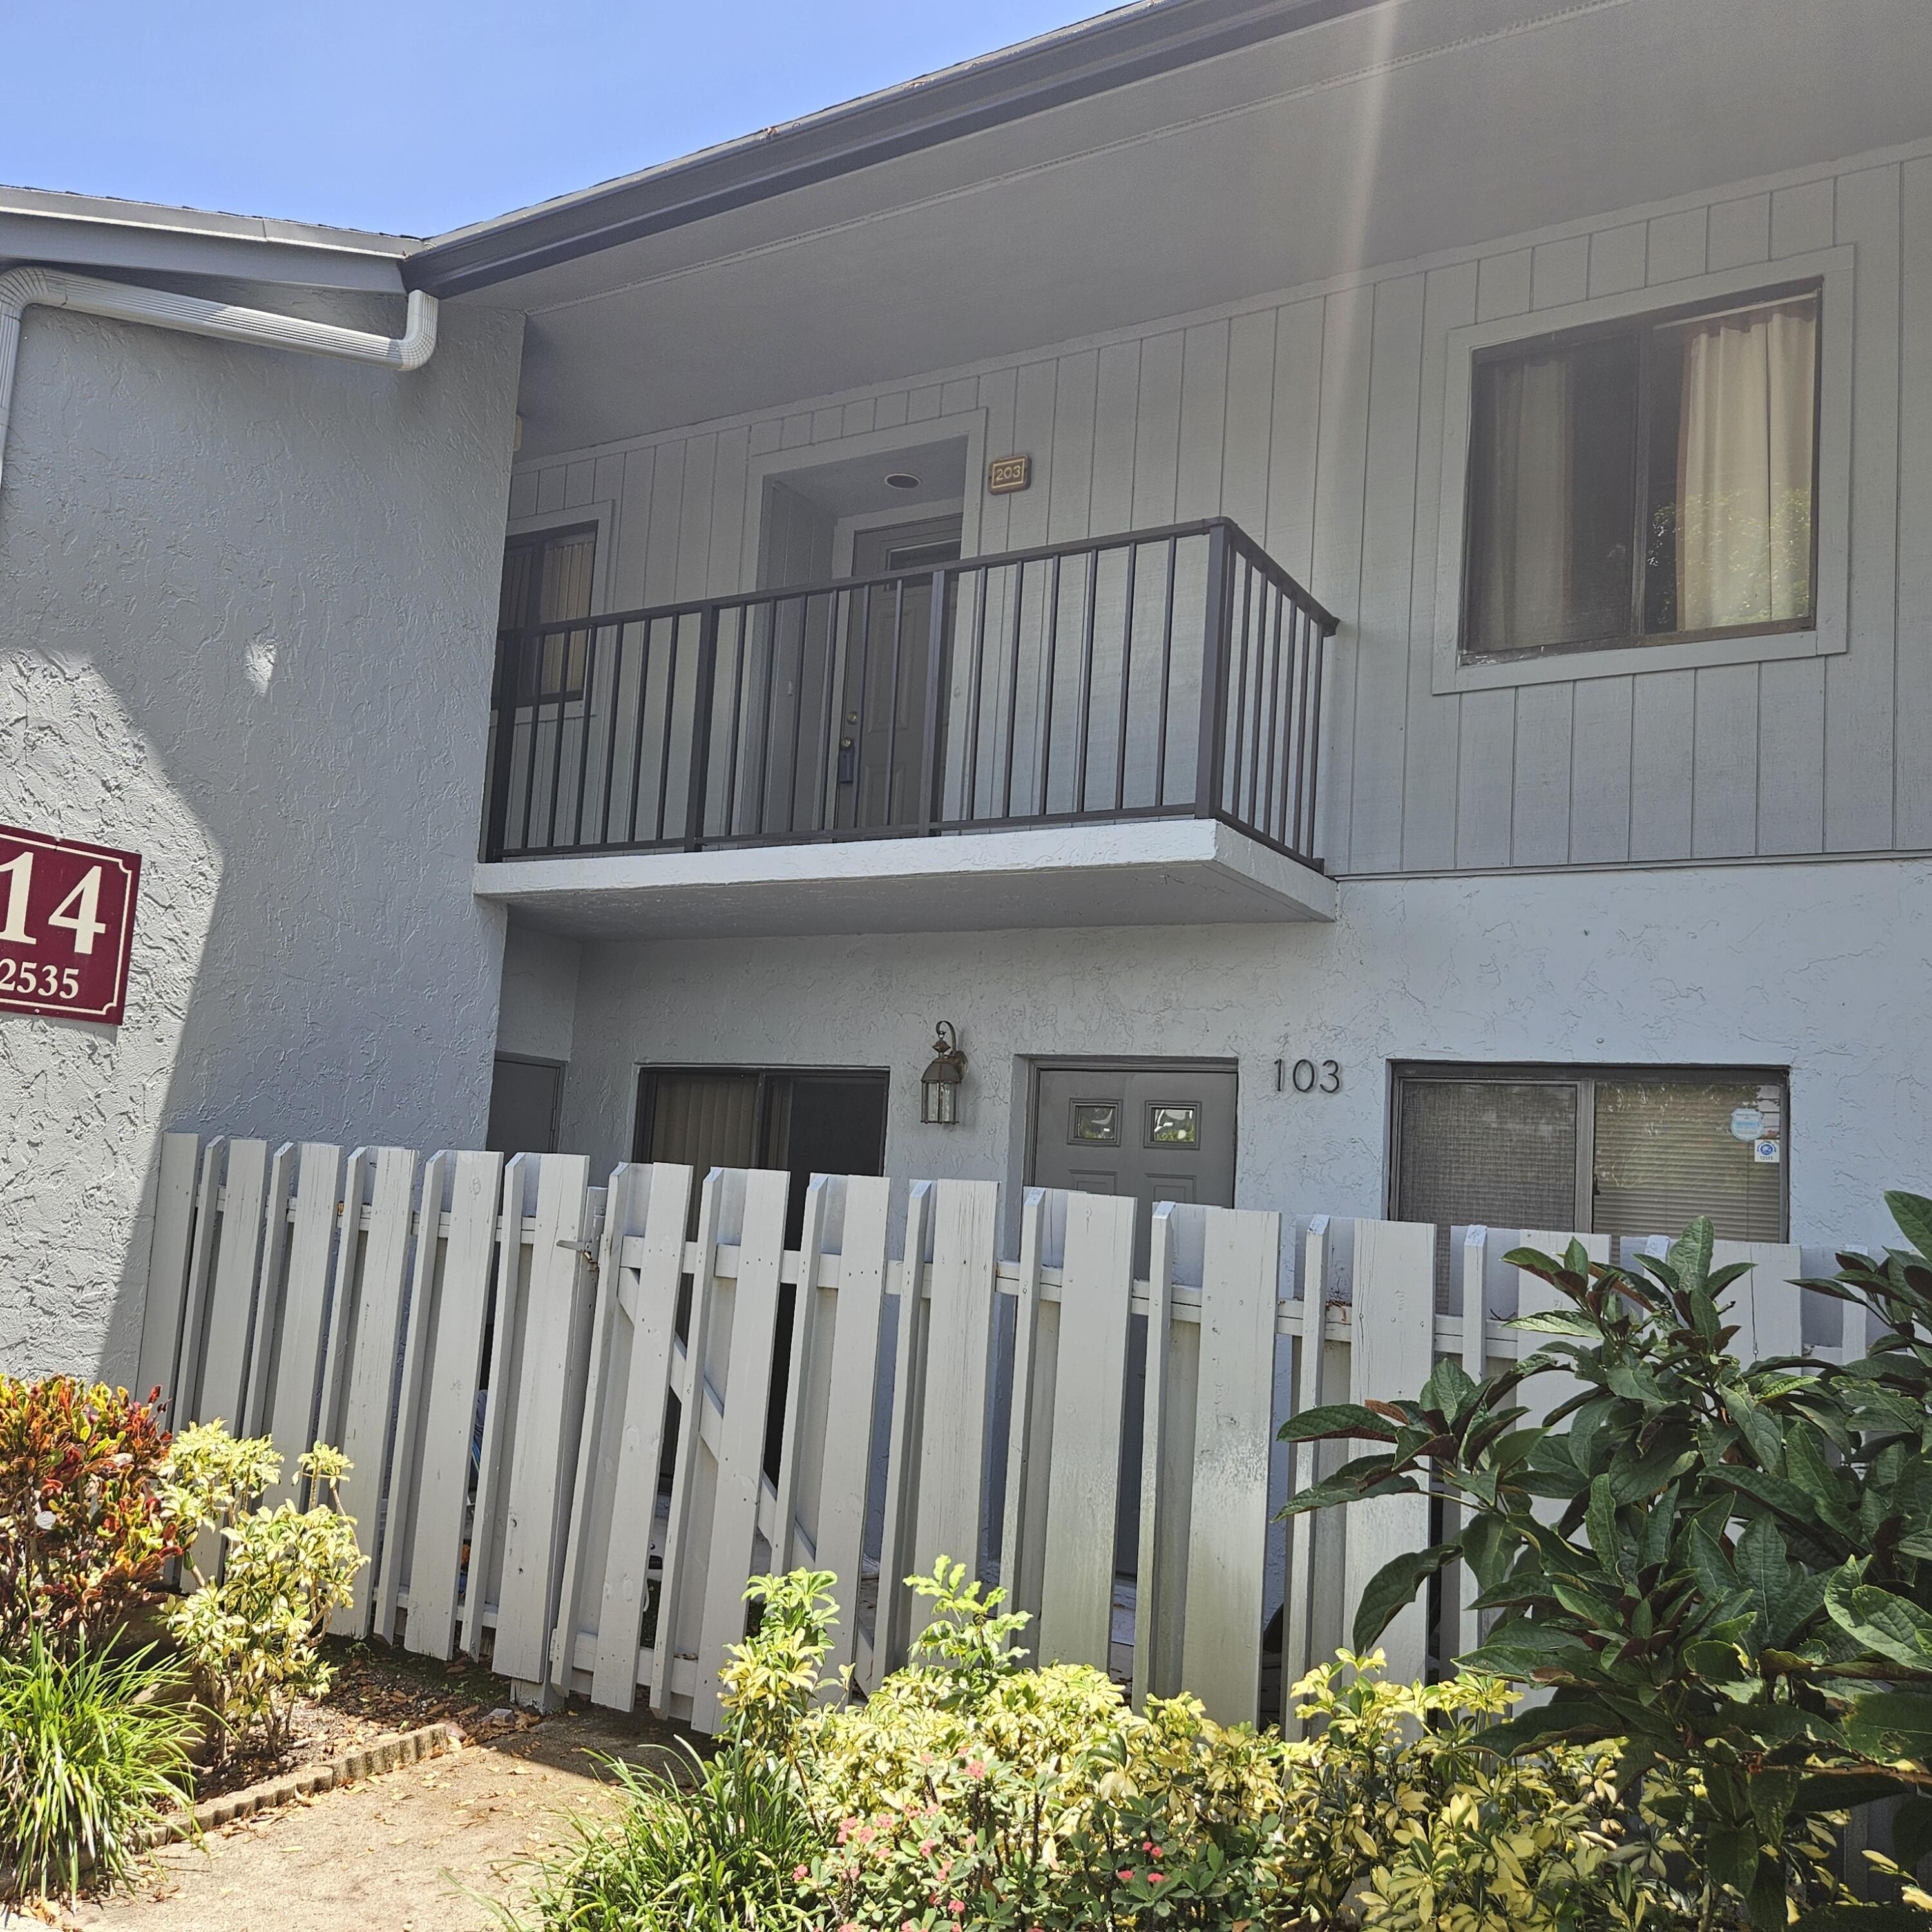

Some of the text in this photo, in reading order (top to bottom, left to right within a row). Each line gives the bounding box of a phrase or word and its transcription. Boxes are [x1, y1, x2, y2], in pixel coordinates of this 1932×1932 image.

[996, 465, 1021, 481] 203
[0, 851, 106, 955] 14
[0, 958, 79, 999] 2535
[1274, 1058, 1340, 1093] 103
